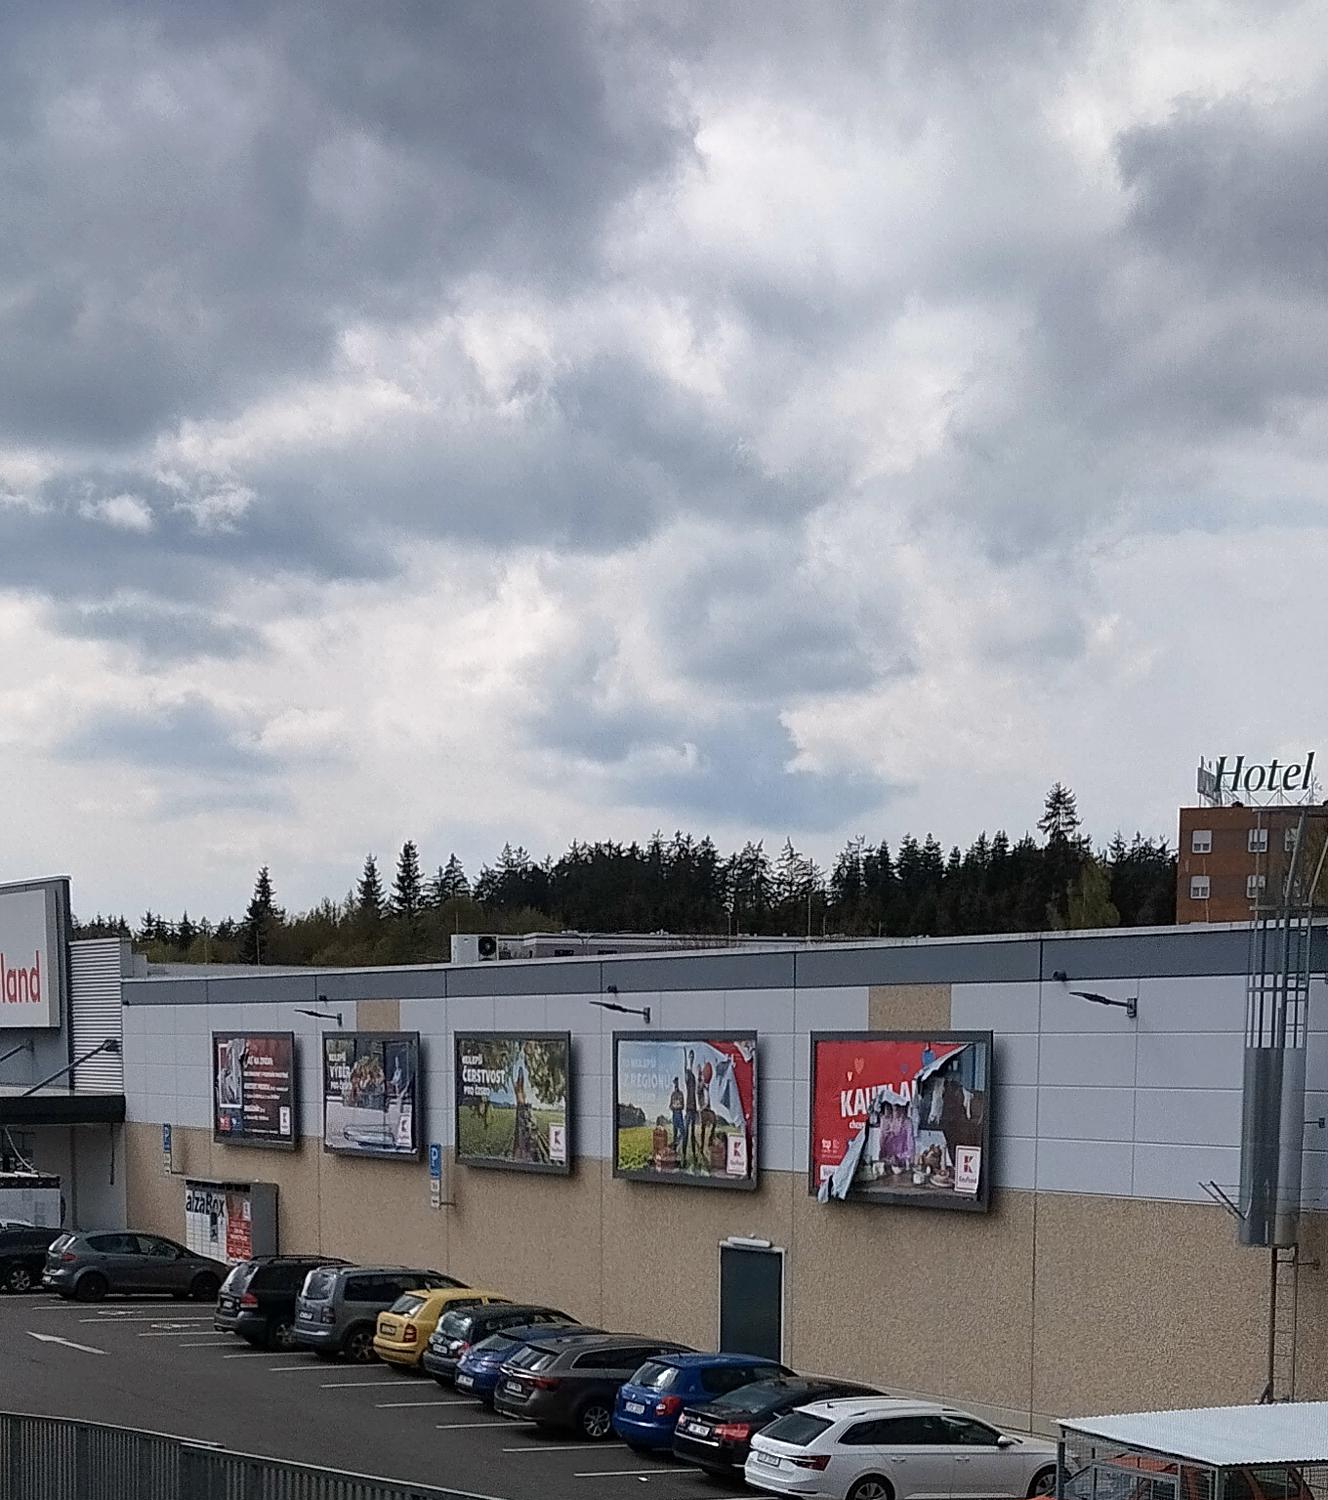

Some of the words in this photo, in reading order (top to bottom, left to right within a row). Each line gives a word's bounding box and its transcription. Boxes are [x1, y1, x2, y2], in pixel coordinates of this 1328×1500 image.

[1214, 751, 1315, 791] Hotel
[462, 1065, 506, 1084] ČERSTVOST
[840, 1079, 917, 1118] KAUA
[431, 1147, 439, 1168] P
[963, 1155, 974, 1173] K
[186, 1190, 226, 1218] alzaBox
